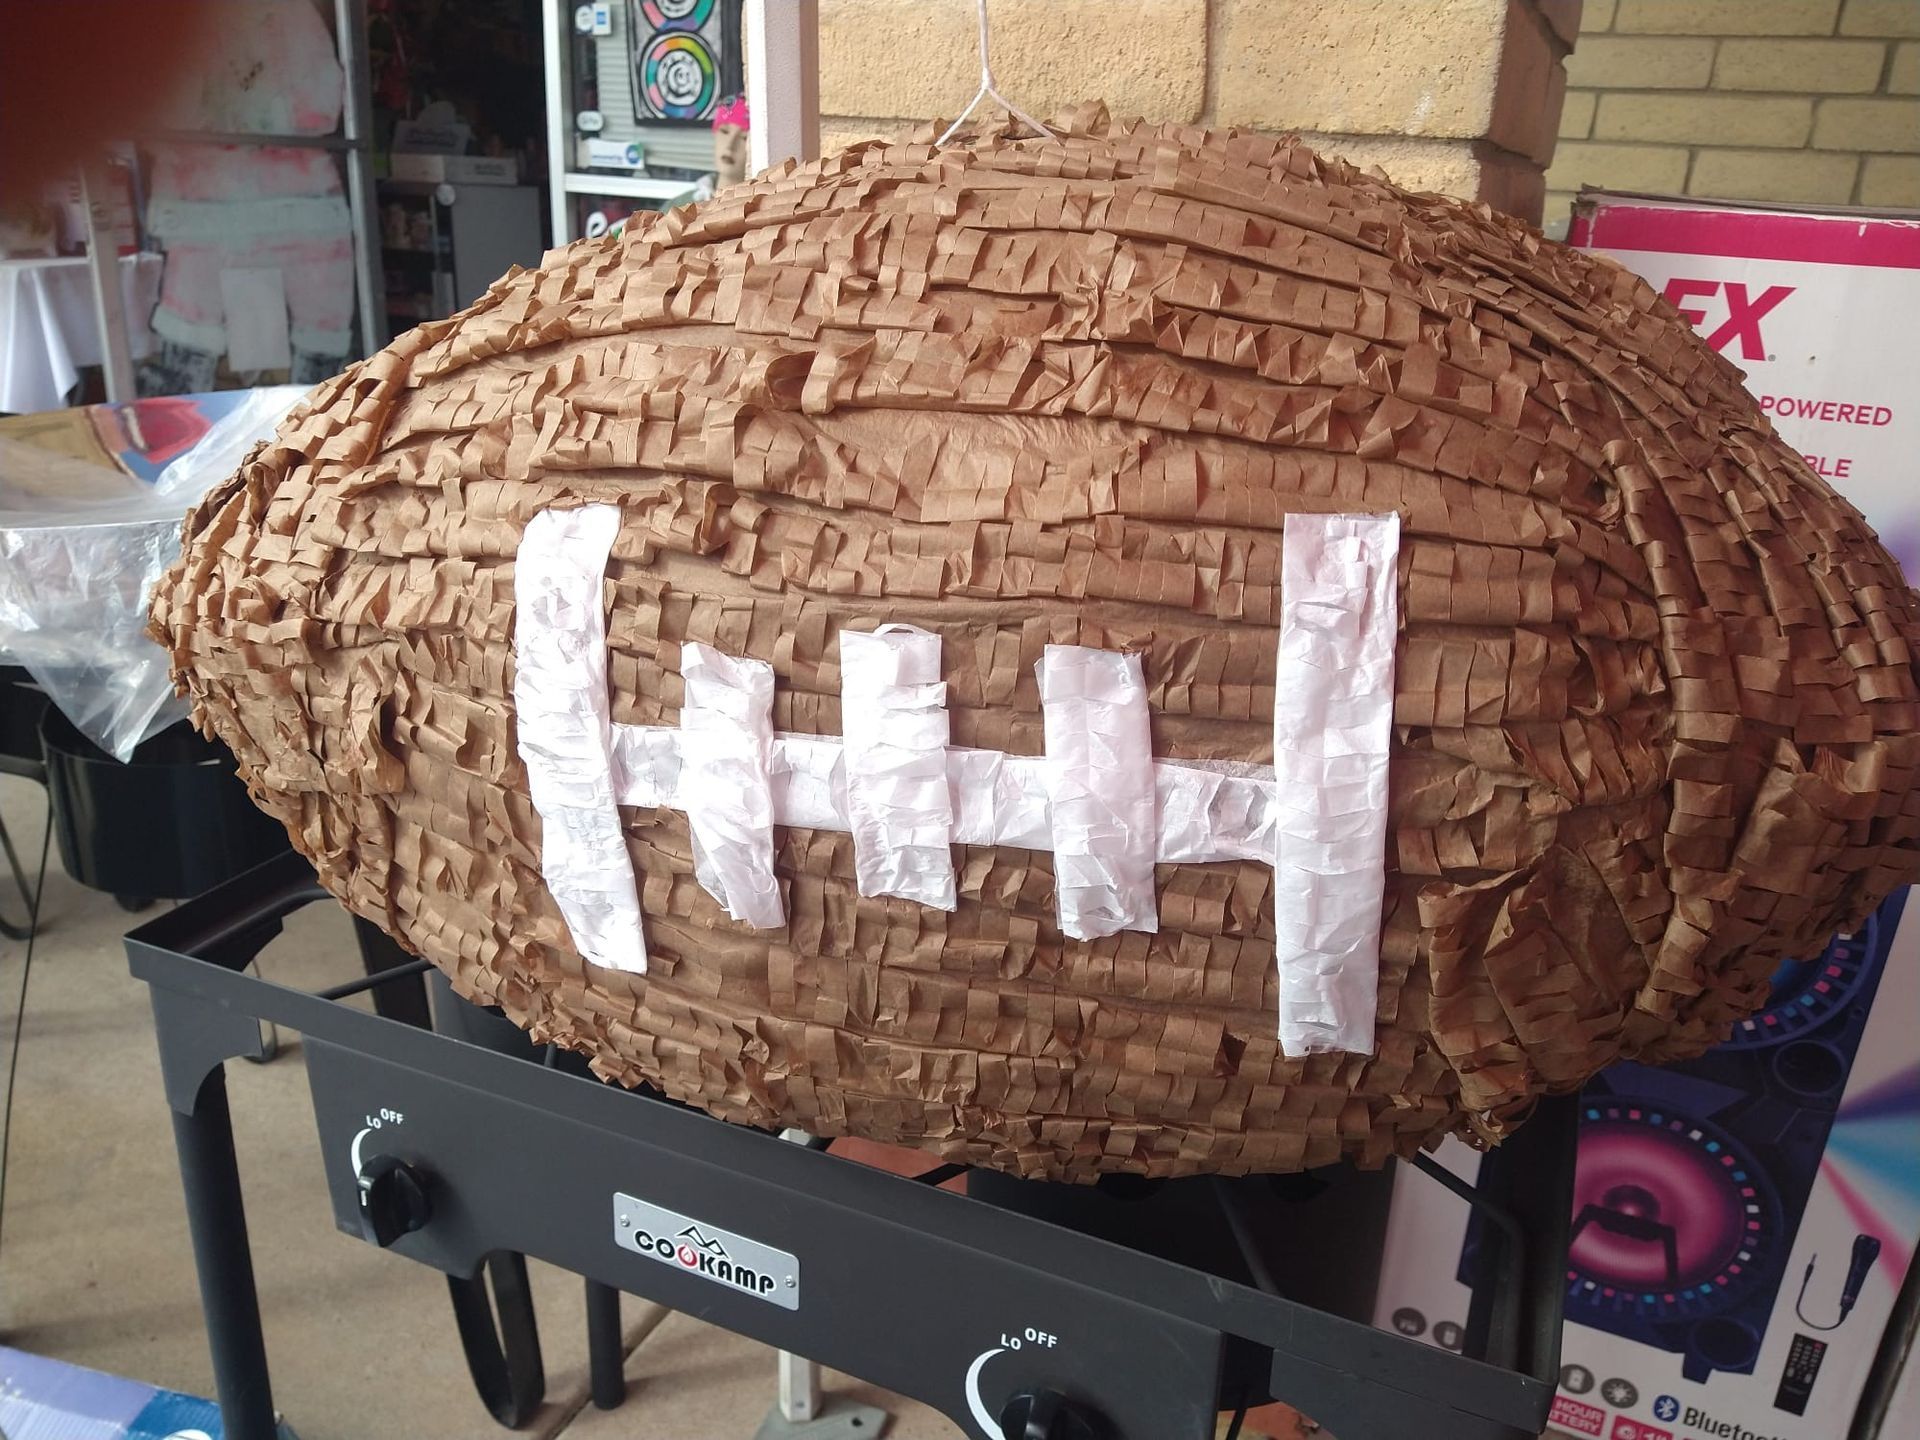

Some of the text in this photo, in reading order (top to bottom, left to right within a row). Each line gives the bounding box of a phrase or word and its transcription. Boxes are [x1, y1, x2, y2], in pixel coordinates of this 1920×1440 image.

[1759, 396, 1892, 426] POWERED
[366, 1115, 381, 1129] LO
[380, 1108, 404, 1125] OFF
[634, 1230, 775, 1294] COOKAMP
[1001, 1333, 1022, 1350] LO
[1024, 1327, 1058, 1349] OFF
[1555, 1398, 1603, 1424] HOUR
[1683, 1407, 1786, 1440] Blueto
